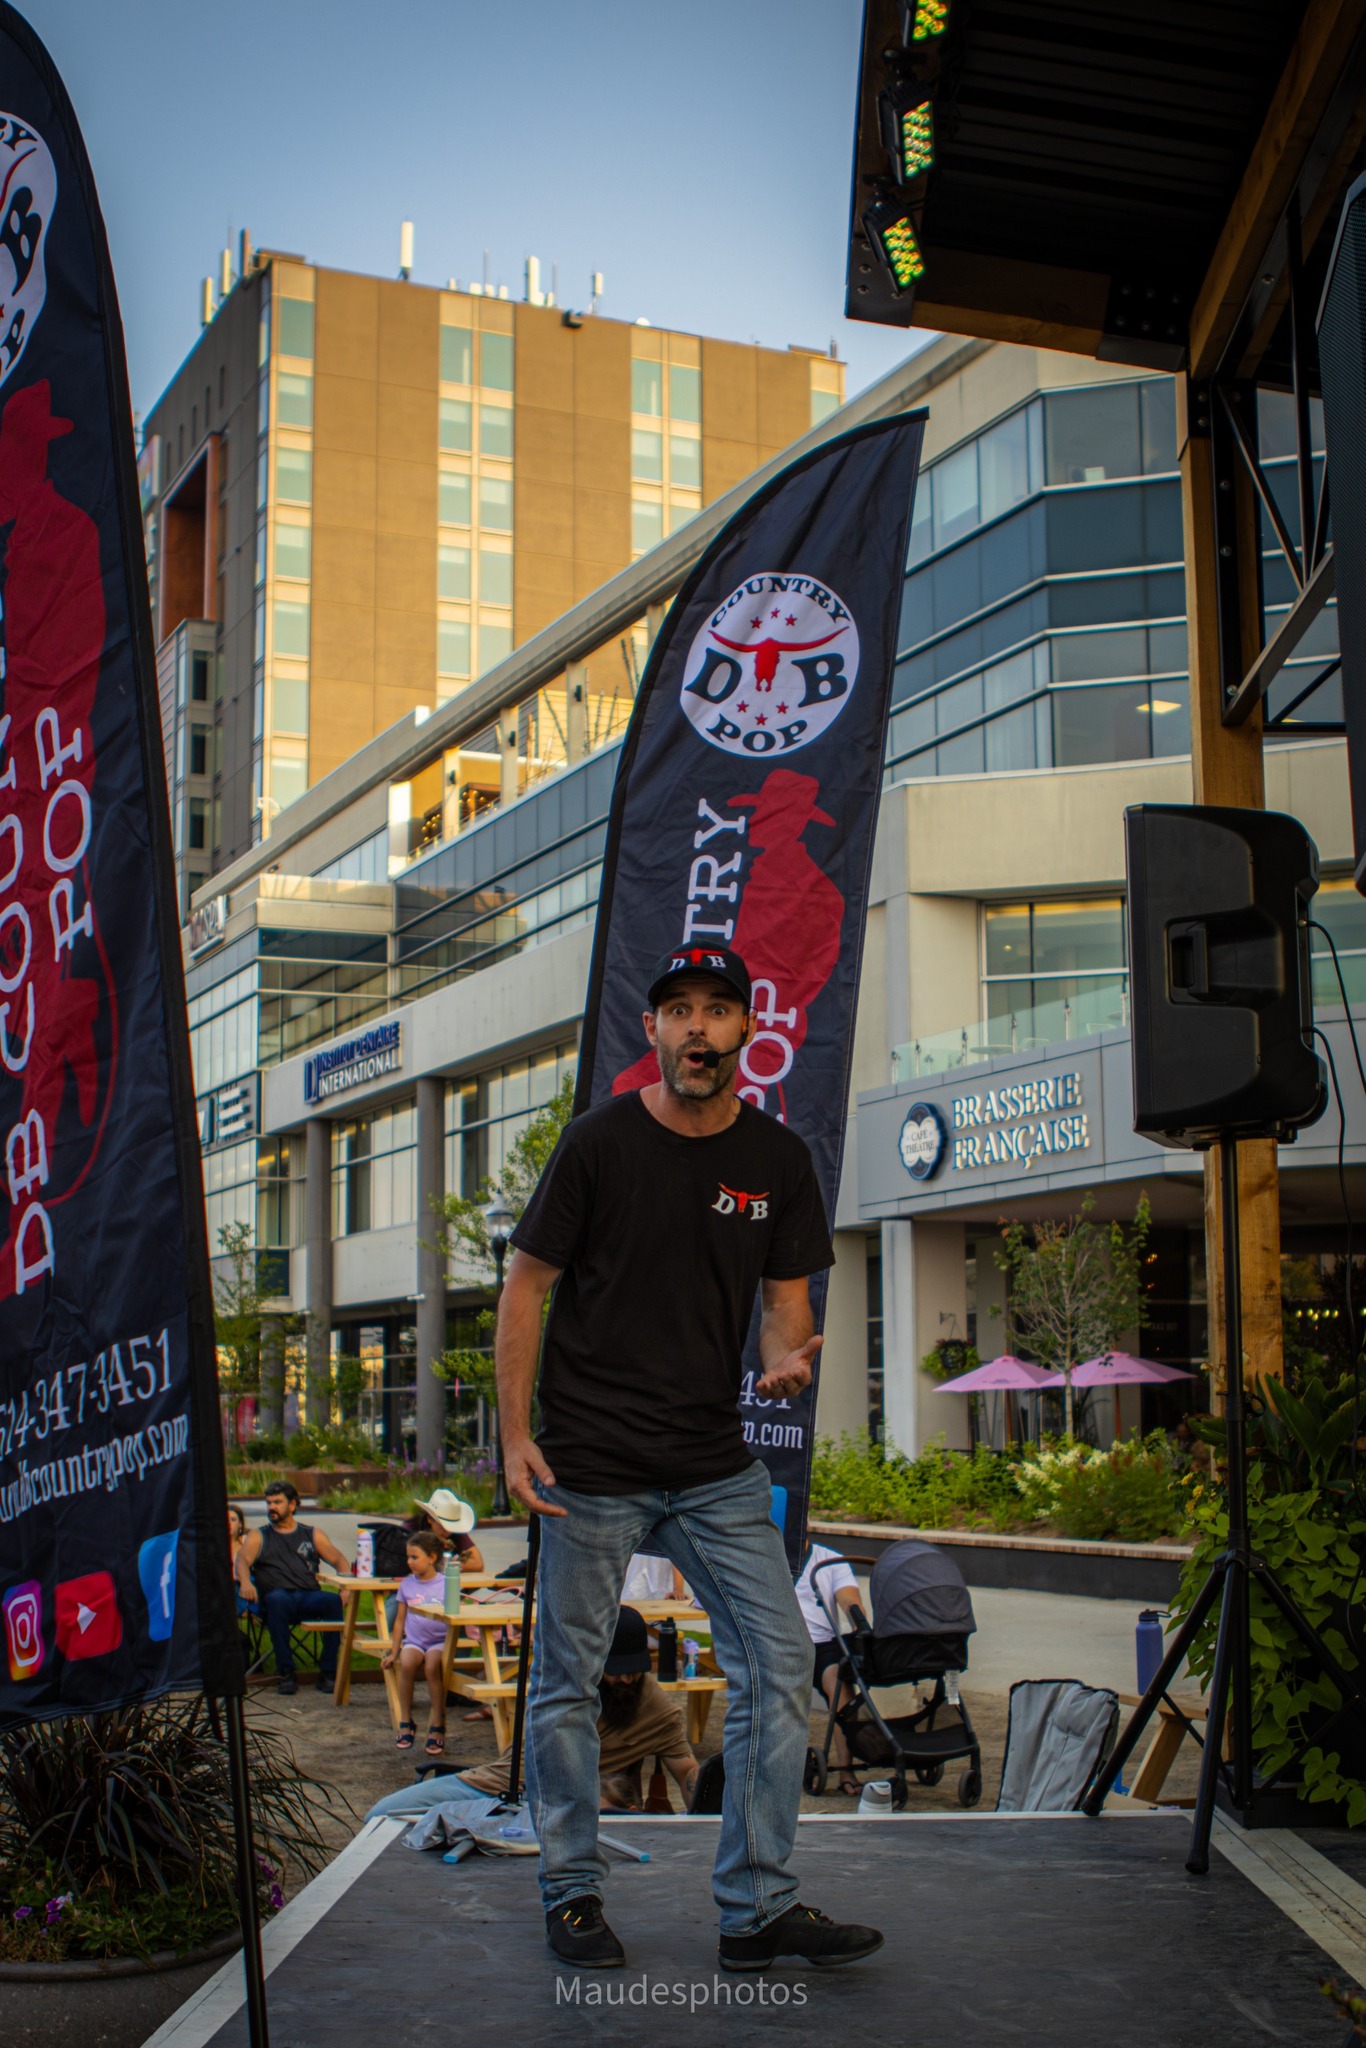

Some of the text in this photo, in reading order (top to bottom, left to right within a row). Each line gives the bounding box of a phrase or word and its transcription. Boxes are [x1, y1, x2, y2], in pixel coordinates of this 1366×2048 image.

[711, 576, 851, 628] COUNTRY
[705, 713, 808, 753] POP
[35, 707, 93, 963] POP
[317, 1047, 399, 1098] INTERNATIONAL
[952, 1072, 1082, 1130] BRASSERIE
[952, 1114, 1090, 1170] FRANÇAISE
[6, 1108, 55, 1295] DB
